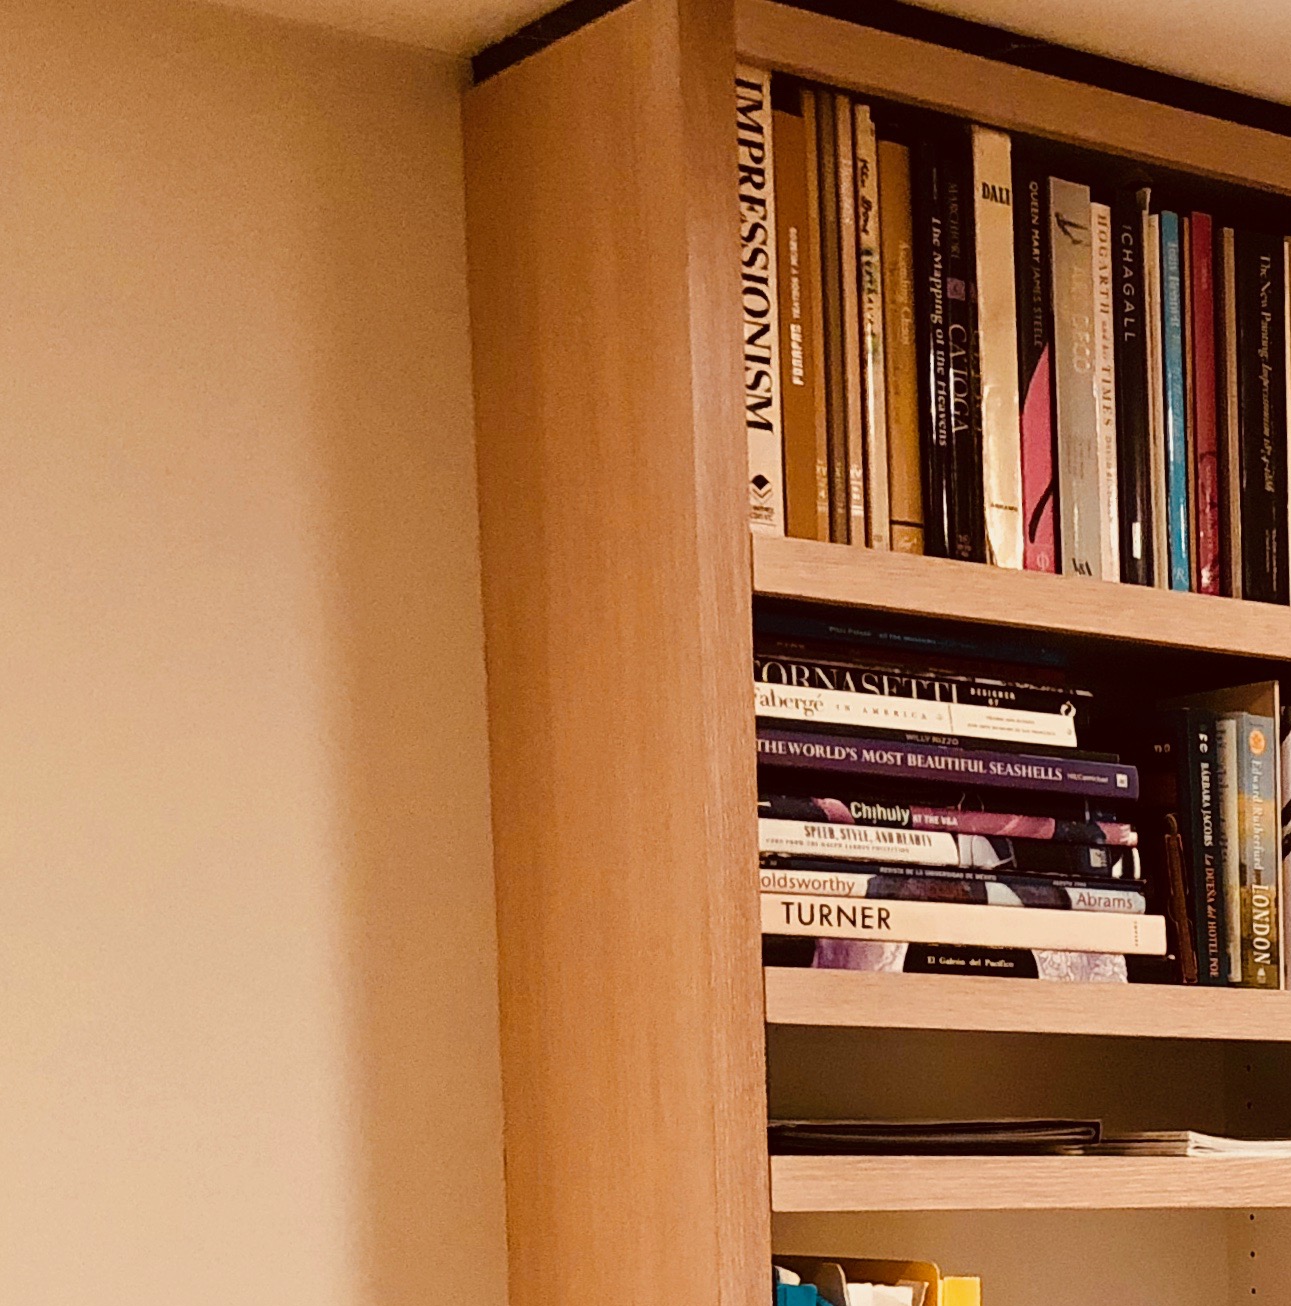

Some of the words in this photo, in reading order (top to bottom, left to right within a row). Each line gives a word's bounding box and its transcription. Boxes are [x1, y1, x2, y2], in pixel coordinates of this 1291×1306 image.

[981, 182, 1011, 207] DALI
[1029, 181, 1041, 225] QUEEN
[930, 216, 944, 244] The
[1030, 229, 1042, 264] MARY
[736, 78, 774, 434] IMPRESSIONISM
[1097, 213, 1109, 315] HOGARTH
[1259, 253, 1272, 278] The
[928, 251, 946, 324] Mapping
[1032, 266, 1043, 302] JAMES
[1260, 280, 1273, 308] New
[1032, 304, 1044, 347] STEELE
[936, 381, 951, 448] Heavens
[1100, 366, 1114, 428] TIMES
[754, 659, 960, 705] ORNASETTI
[862, 706, 928, 720] AMERICA
[755, 740, 787, 754] THE
[787, 741, 860, 762] WORLD'S
[862, 748, 904, 768] MOST
[907, 753, 986, 774] BEAUTIFUL
[988, 761, 1063, 783] SEASHELLS
[1251, 759, 1263, 803] Edward
[849, 800, 910, 826] Chihuly
[1201, 808, 1215, 847] JACOBS
[760, 871, 856, 896] oldsworthy
[1076, 891, 1134, 909] Abrams
[1204, 866, 1218, 904] DUEÑA
[780, 901, 892, 930] TURNER
[1205, 904, 1218, 919] del
[1251, 883, 1272, 966] LONDON
[1207, 920, 1220, 954] HOTEL
[1208, 957, 1220, 979] POE
